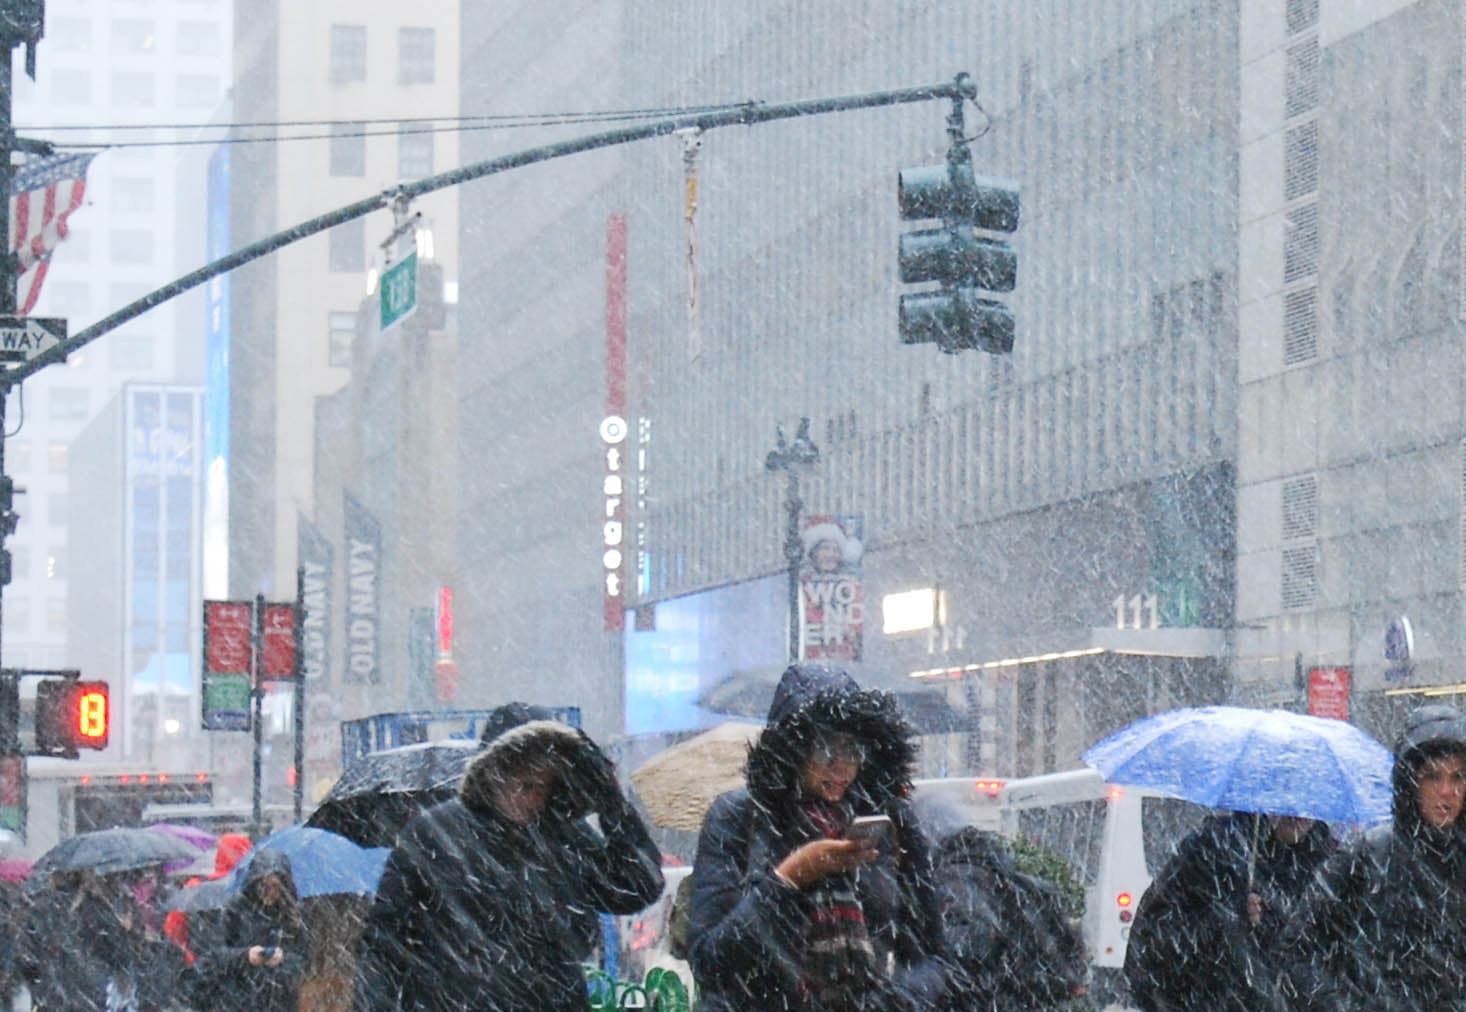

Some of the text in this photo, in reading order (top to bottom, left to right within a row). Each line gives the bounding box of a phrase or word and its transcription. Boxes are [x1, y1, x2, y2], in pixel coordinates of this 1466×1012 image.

[2, 331, 45, 350] WAY
[349, 538, 375, 674] OLD NAVY
[1111, 593, 1159, 630] 111
